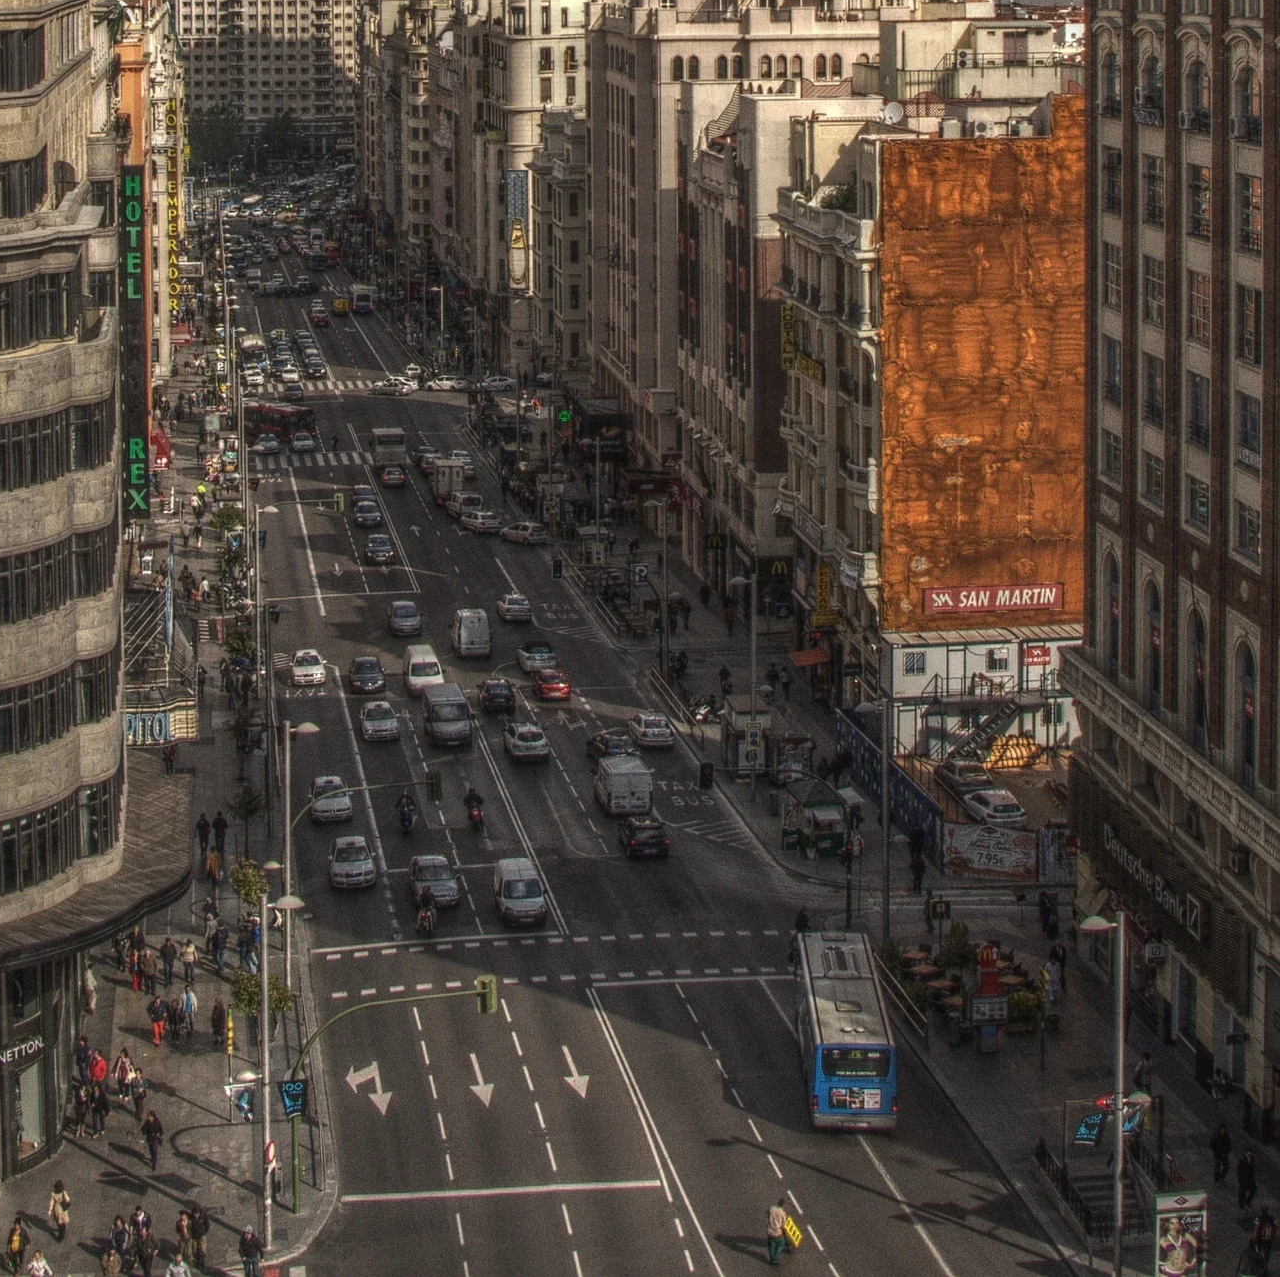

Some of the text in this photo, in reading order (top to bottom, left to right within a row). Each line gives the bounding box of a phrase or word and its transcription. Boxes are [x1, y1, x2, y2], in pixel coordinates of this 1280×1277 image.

[124, 175, 142, 300] HOTEL
[166, 180, 180, 311] EMPERADOR
[128, 438, 148, 511] REX
[958, 590, 990, 607] SAN
[995, 587, 1056, 606] MARTIN
[1103, 822, 1153, 890] Deutsche
[1154, 874, 1186, 926] Bank
